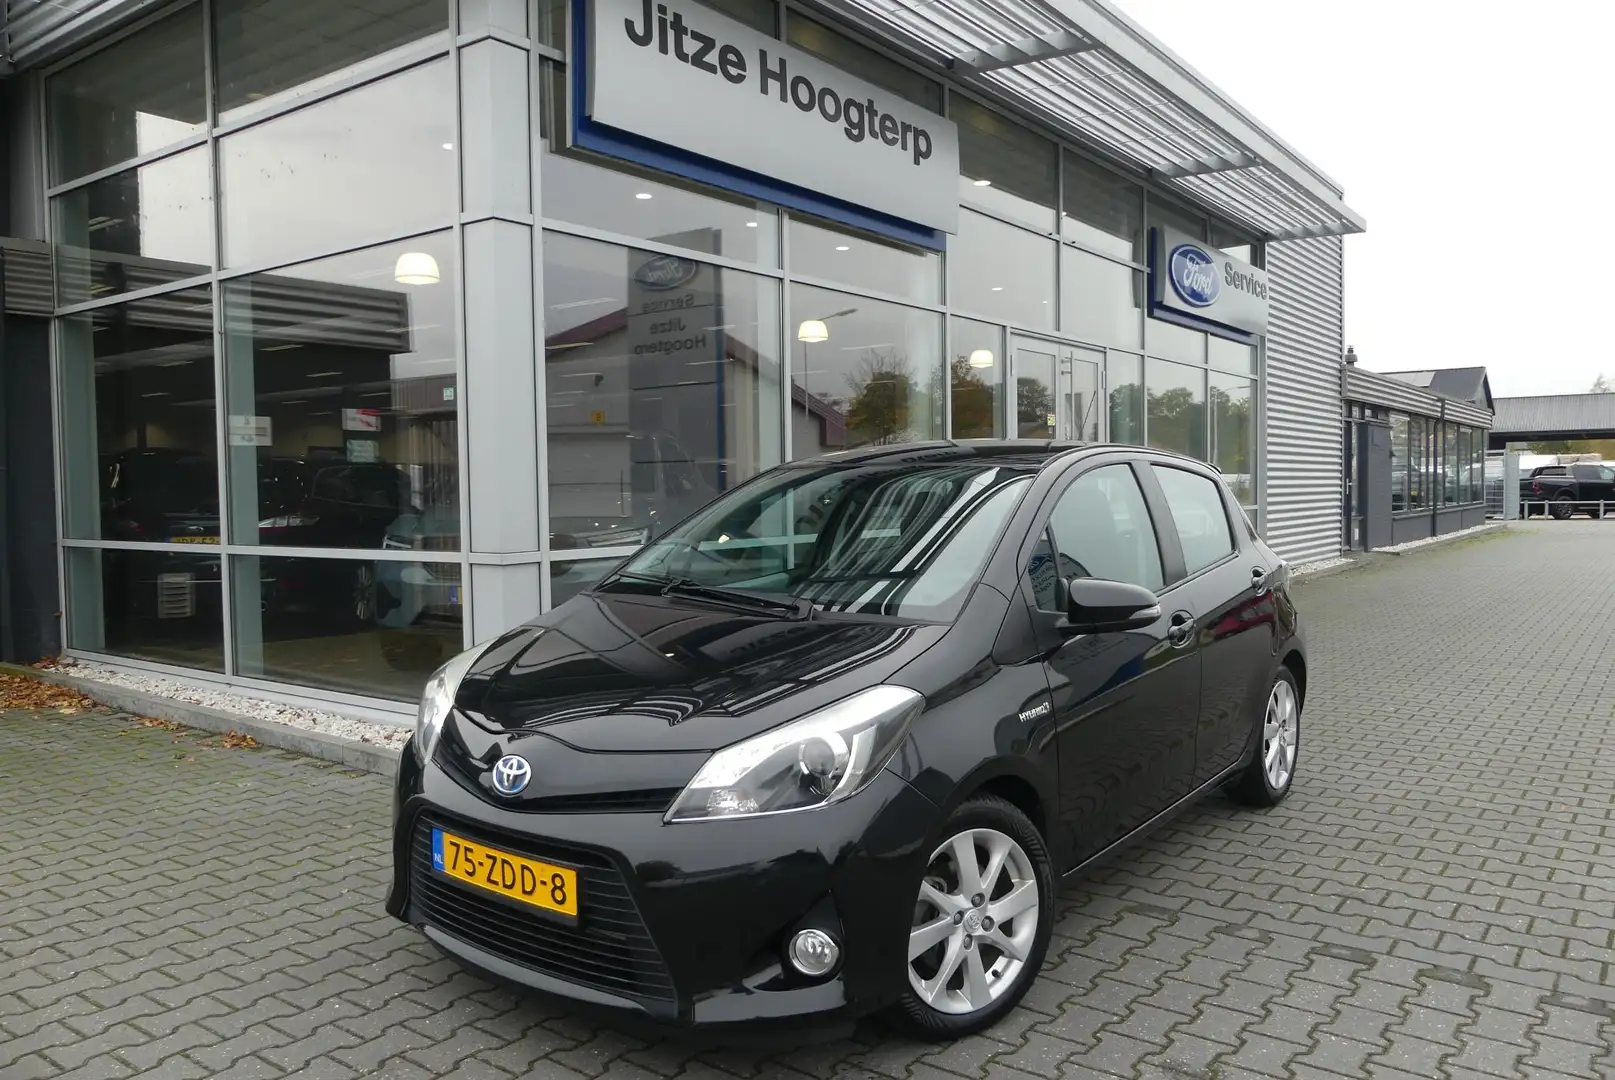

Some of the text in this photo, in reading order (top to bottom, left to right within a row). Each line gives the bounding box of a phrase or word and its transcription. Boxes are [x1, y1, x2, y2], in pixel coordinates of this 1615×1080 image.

[624, 0, 933, 166] Jitze Hoogterp
[1183, 253, 1268, 300] Ford Service
[1018, 705, 1045, 722] HYBRID
[434, 840, 567, 906] NL 75-ZDD-8
